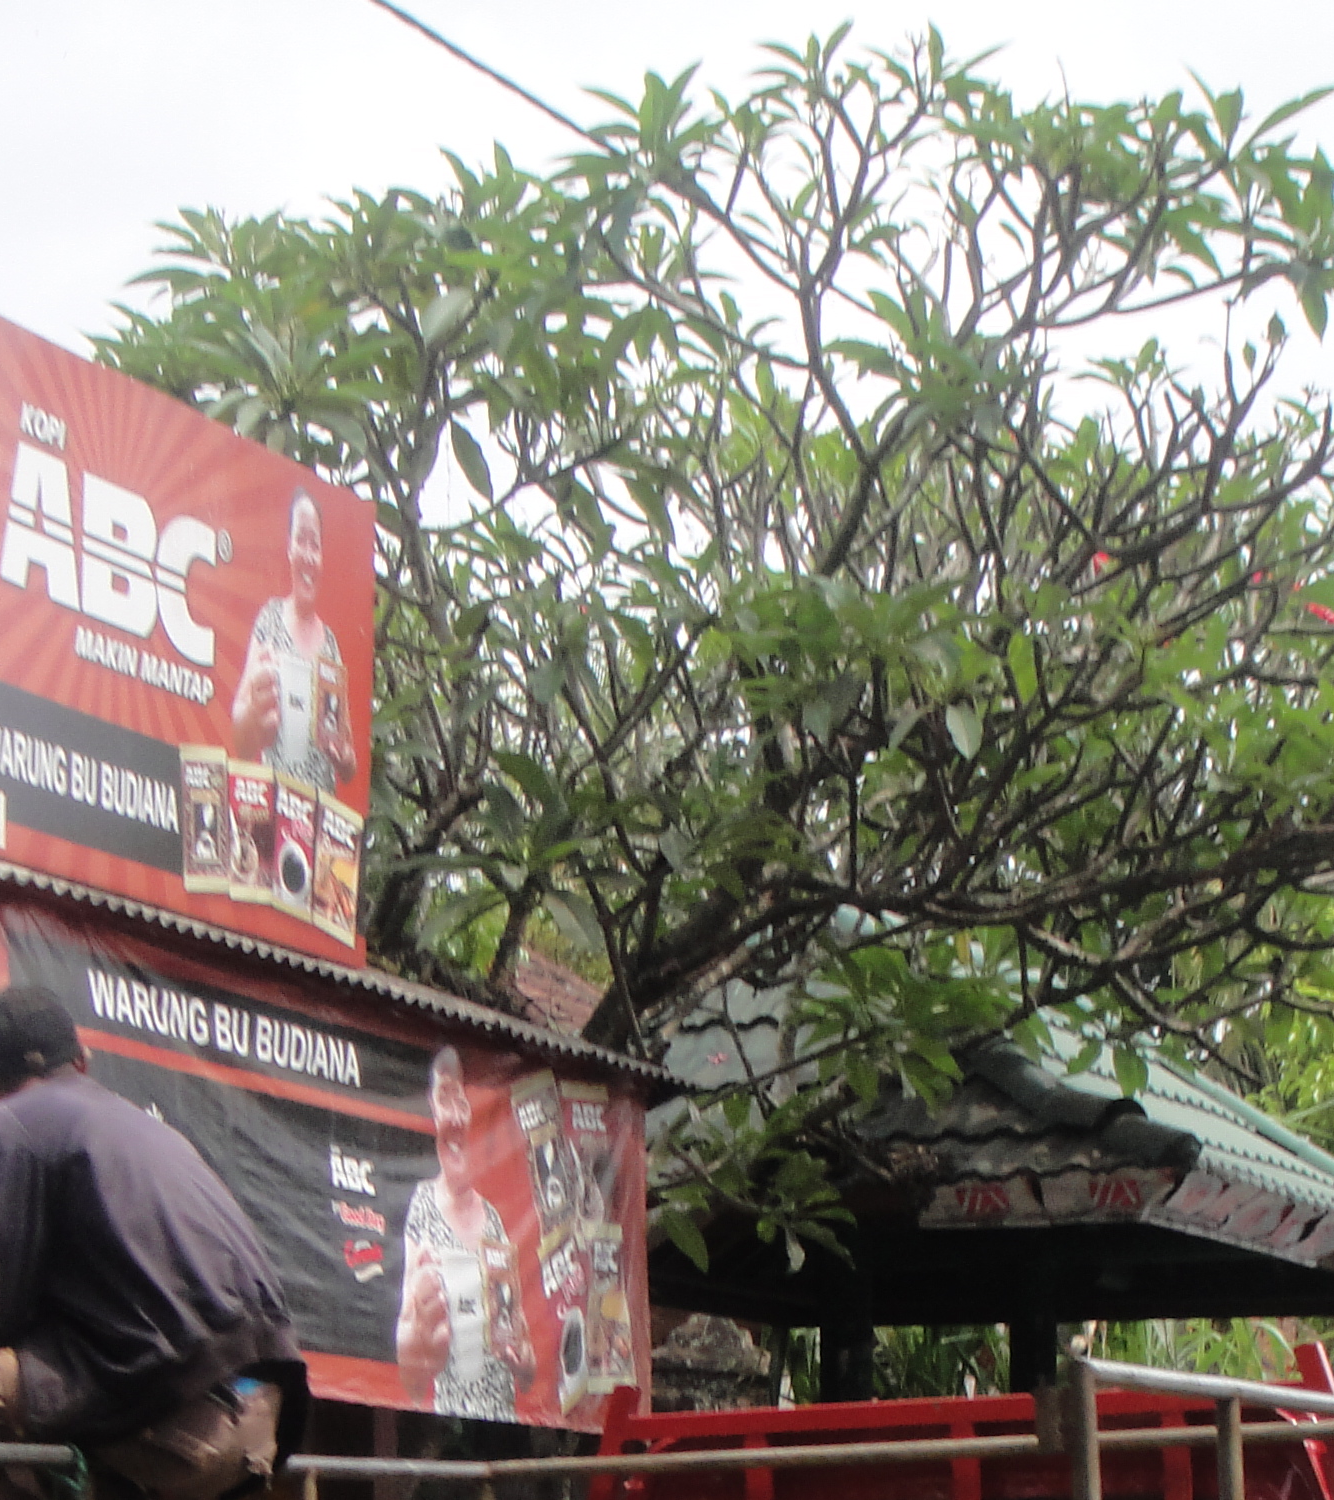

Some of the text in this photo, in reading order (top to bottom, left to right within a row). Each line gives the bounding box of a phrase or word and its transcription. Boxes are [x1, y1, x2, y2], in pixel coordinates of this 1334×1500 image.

[20, 400, 67, 451] KOPI
[75, 624, 215, 705] MAKIN MANTAP
[70, 750, 98, 807] BU
[100, 761, 179, 834] BUDIANA
[87, 967, 361, 1088] WARUNG BU BUDIANA
[330, 1153, 377, 1197] ABC
